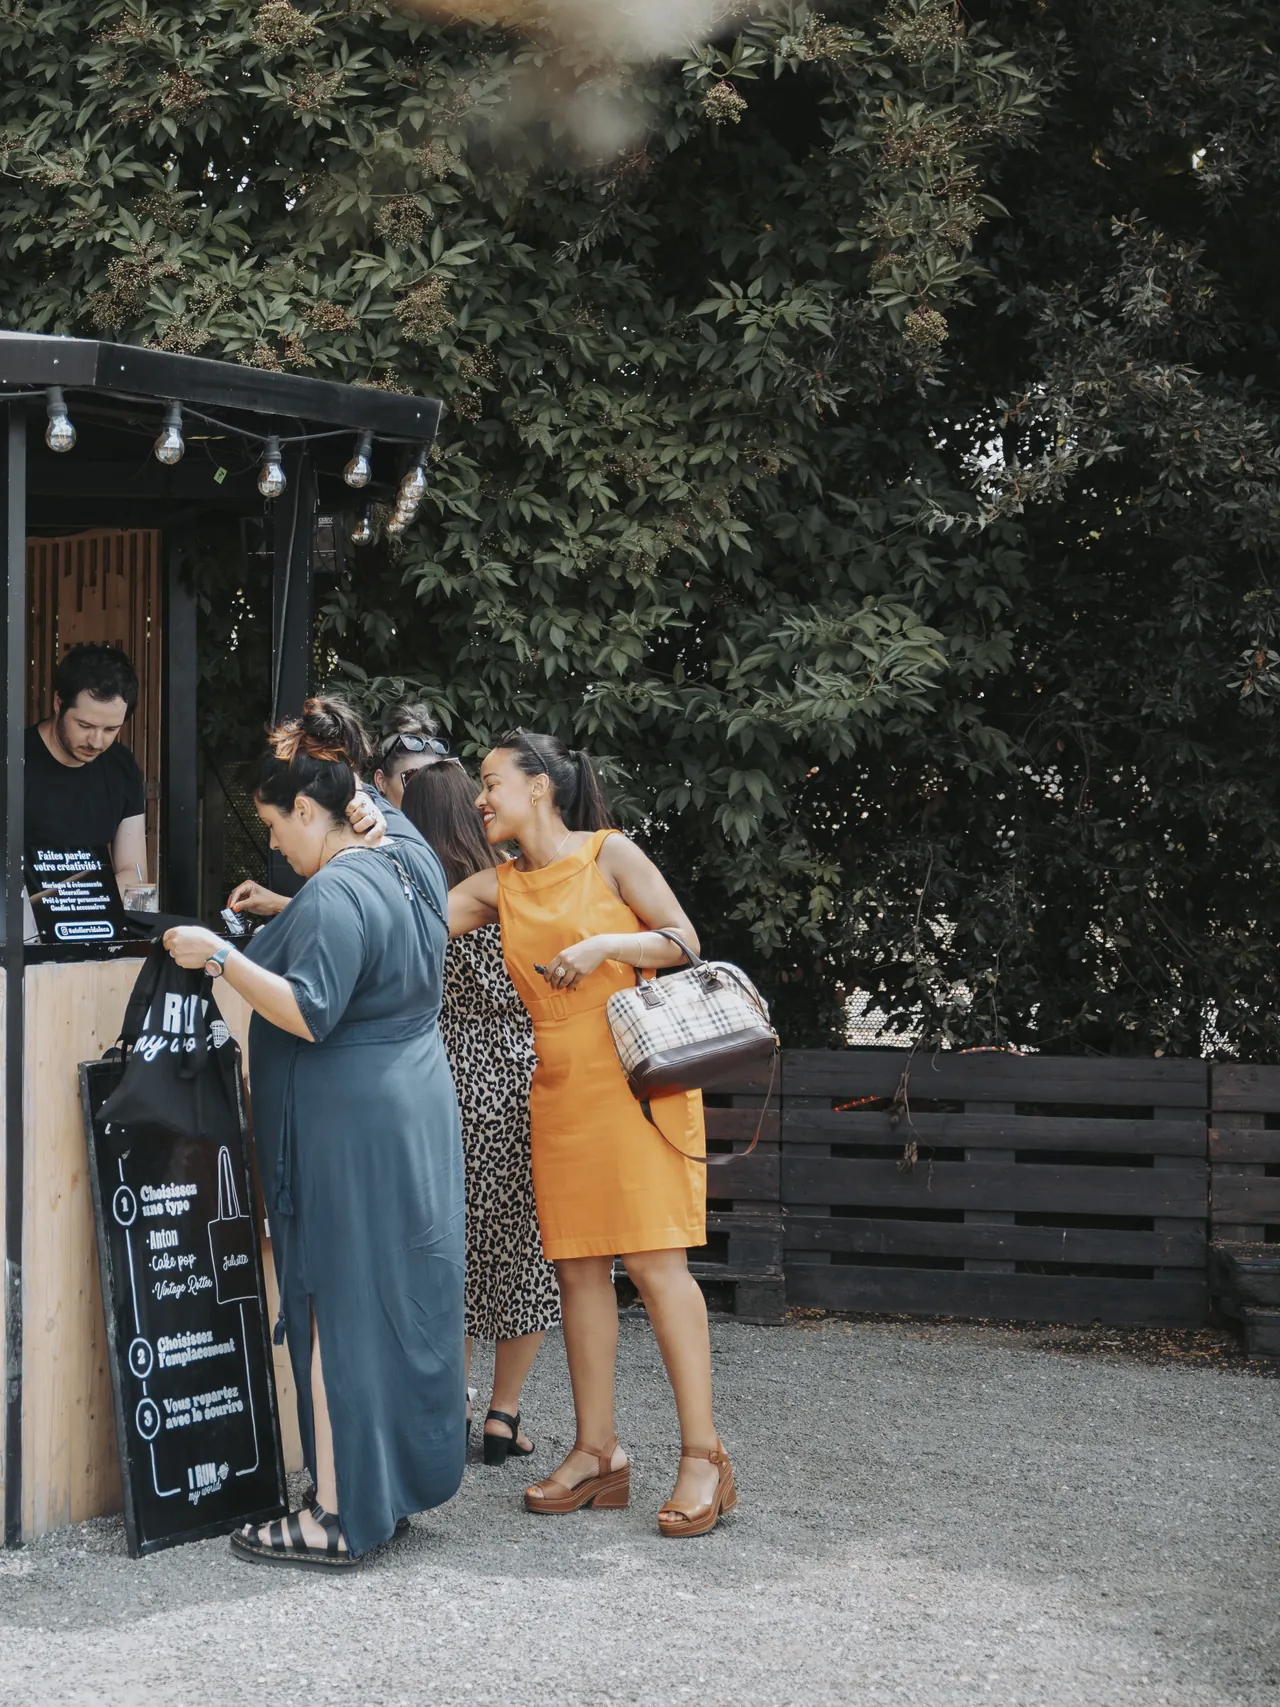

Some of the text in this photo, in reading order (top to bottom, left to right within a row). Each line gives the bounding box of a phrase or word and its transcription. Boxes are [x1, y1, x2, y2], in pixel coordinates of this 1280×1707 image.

[33, 862, 56, 871] votre
[56, 861, 97, 871] créativité
[37, 850, 91, 865] Faites parler
[140, 1182, 198, 1202] Choisissez
[121, 1196, 129, 1212] 1
[141, 1199, 190, 1217] une typo
[150, 1228, 179, 1250] Anton
[152, 1252, 197, 1272] Cake pop
[155, 1274, 213, 1300] Vintage Rotter
[157, 1330, 214, 1353] Choisissez
[137, 1348, 146, 1365] 2
[158, 1337, 236, 1369] l'emplacement
[163, 1385, 239, 1414] Vous repartez
[143, 1409, 153, 1427] 3
[165, 1399, 244, 1429] avec le sourire
[187, 1462, 217, 1490] I RUN
[188, 1491, 201, 1506] my
